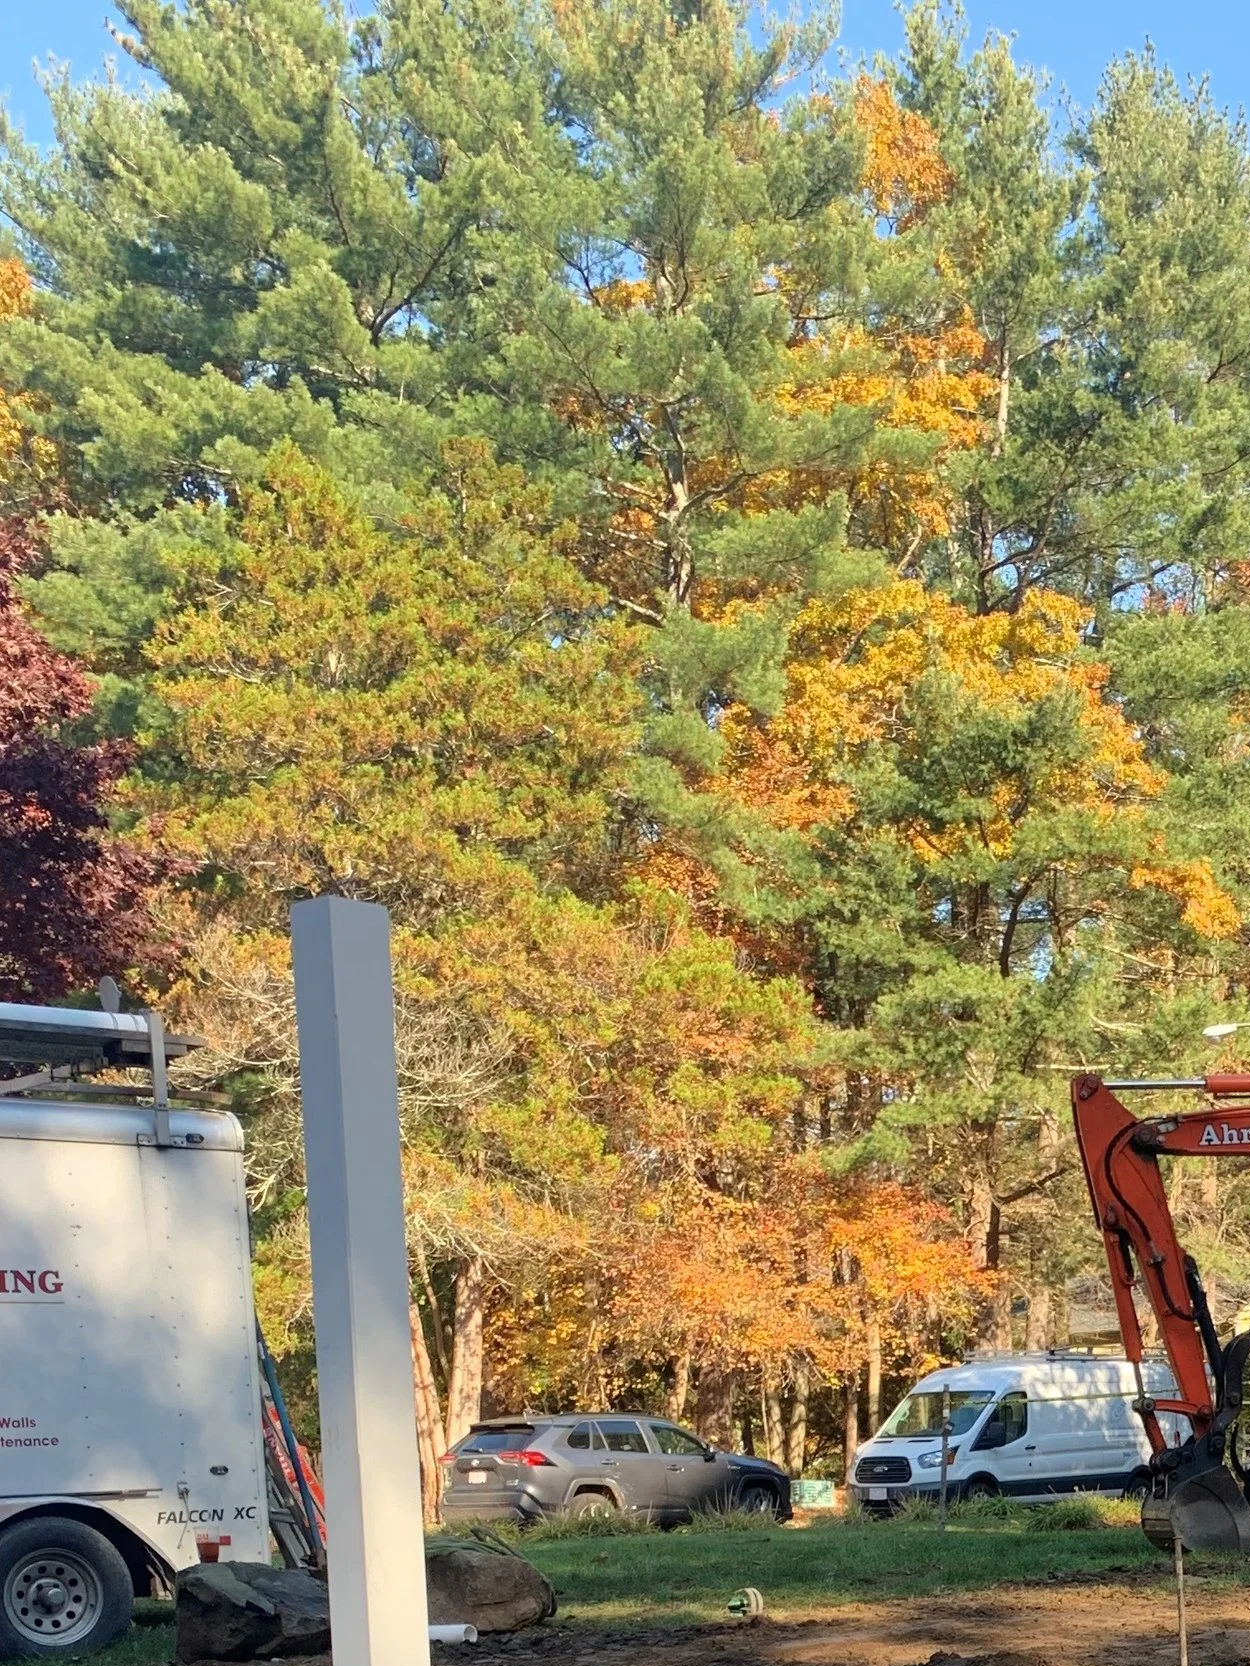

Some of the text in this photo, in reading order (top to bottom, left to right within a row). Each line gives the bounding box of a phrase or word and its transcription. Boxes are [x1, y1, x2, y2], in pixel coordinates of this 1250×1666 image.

[0, 1416, 37, 1428] Walls
[157, 1506, 257, 1525] FALCON XC
